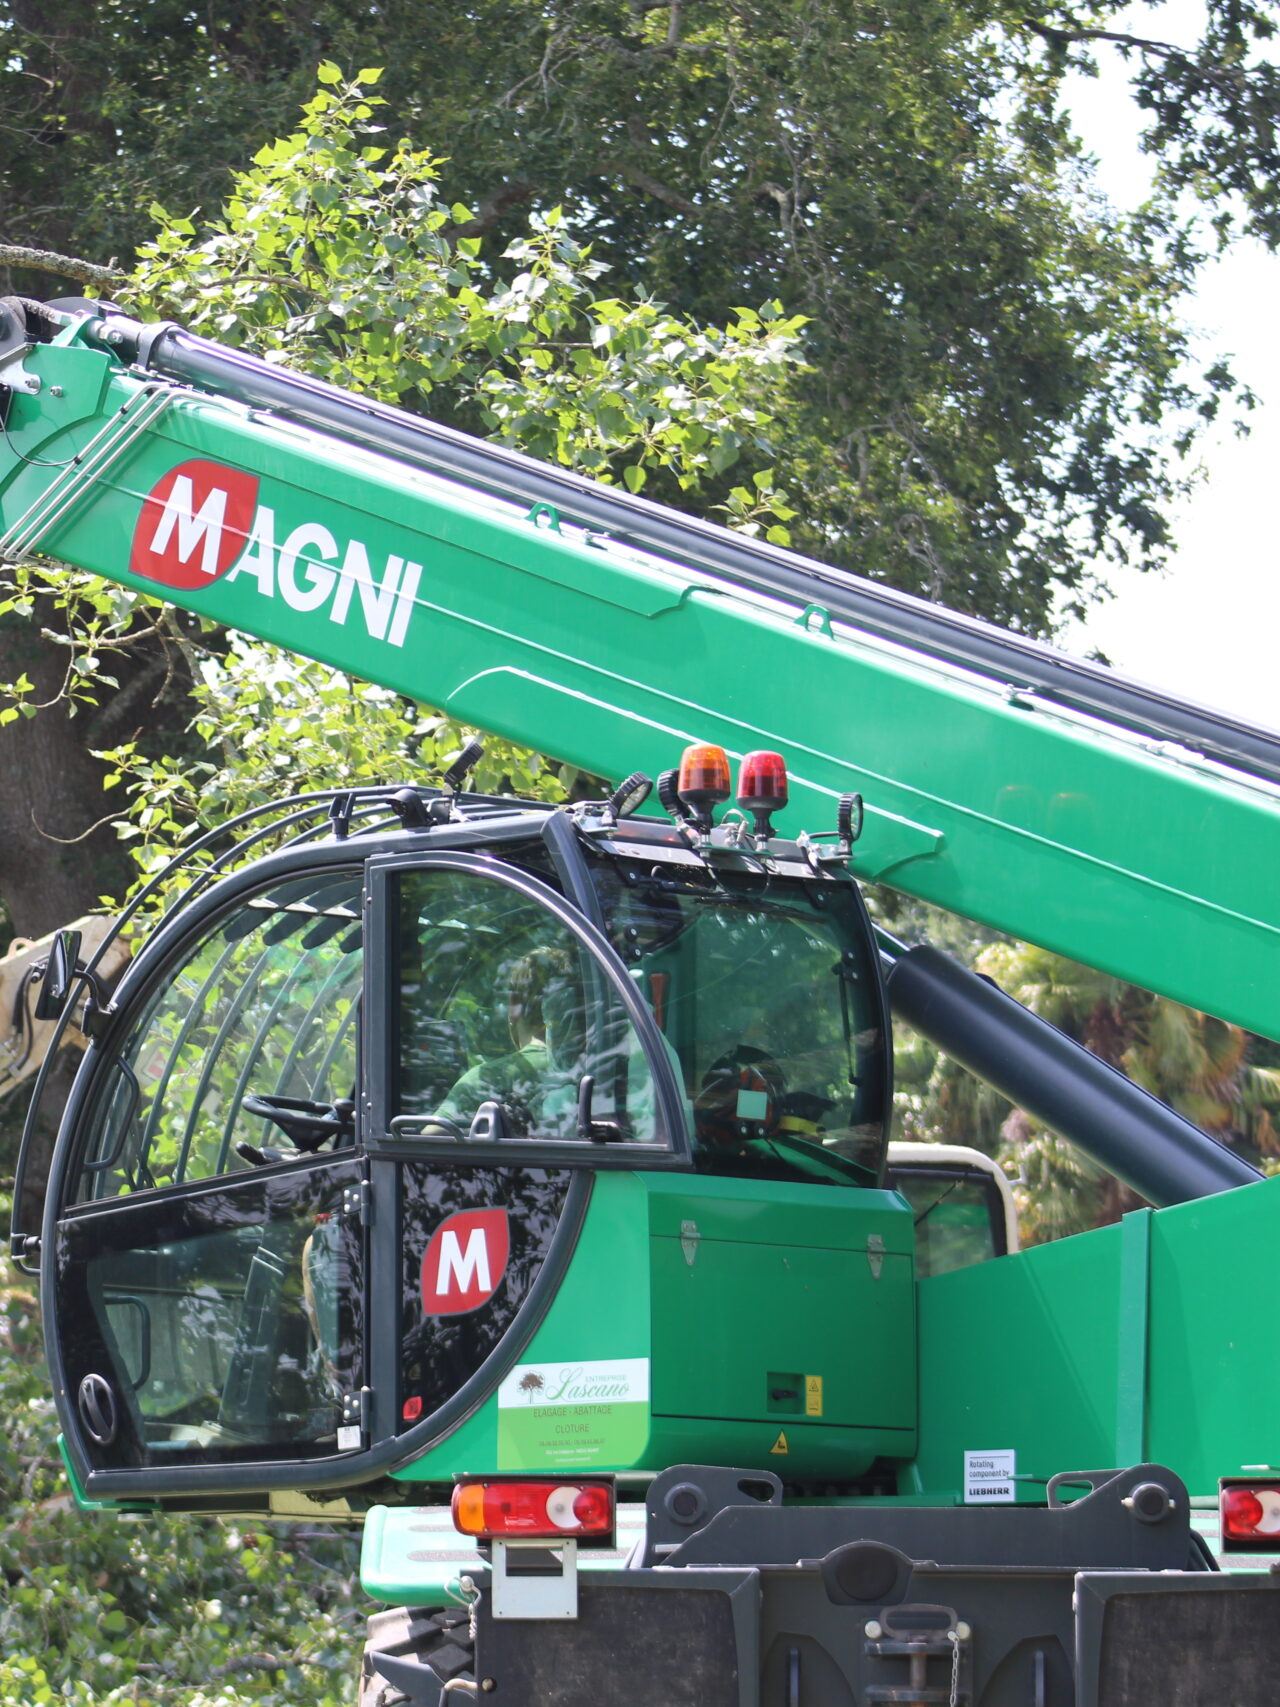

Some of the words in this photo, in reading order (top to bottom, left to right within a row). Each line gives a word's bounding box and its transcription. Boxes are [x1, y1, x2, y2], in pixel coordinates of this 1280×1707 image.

[150, 474, 423, 648] MAGNI
[436, 1228, 492, 1296] M
[545, 1366, 630, 1401] Lascano
[574, 1405, 613, 1416] ABATTAGE
[969, 1460, 994, 1470] Rotating
[969, 1469, 1002, 1478] component
[1002, 1468, 1009, 1478] by
[969, 1487, 1010, 1496] LIEBHERR
